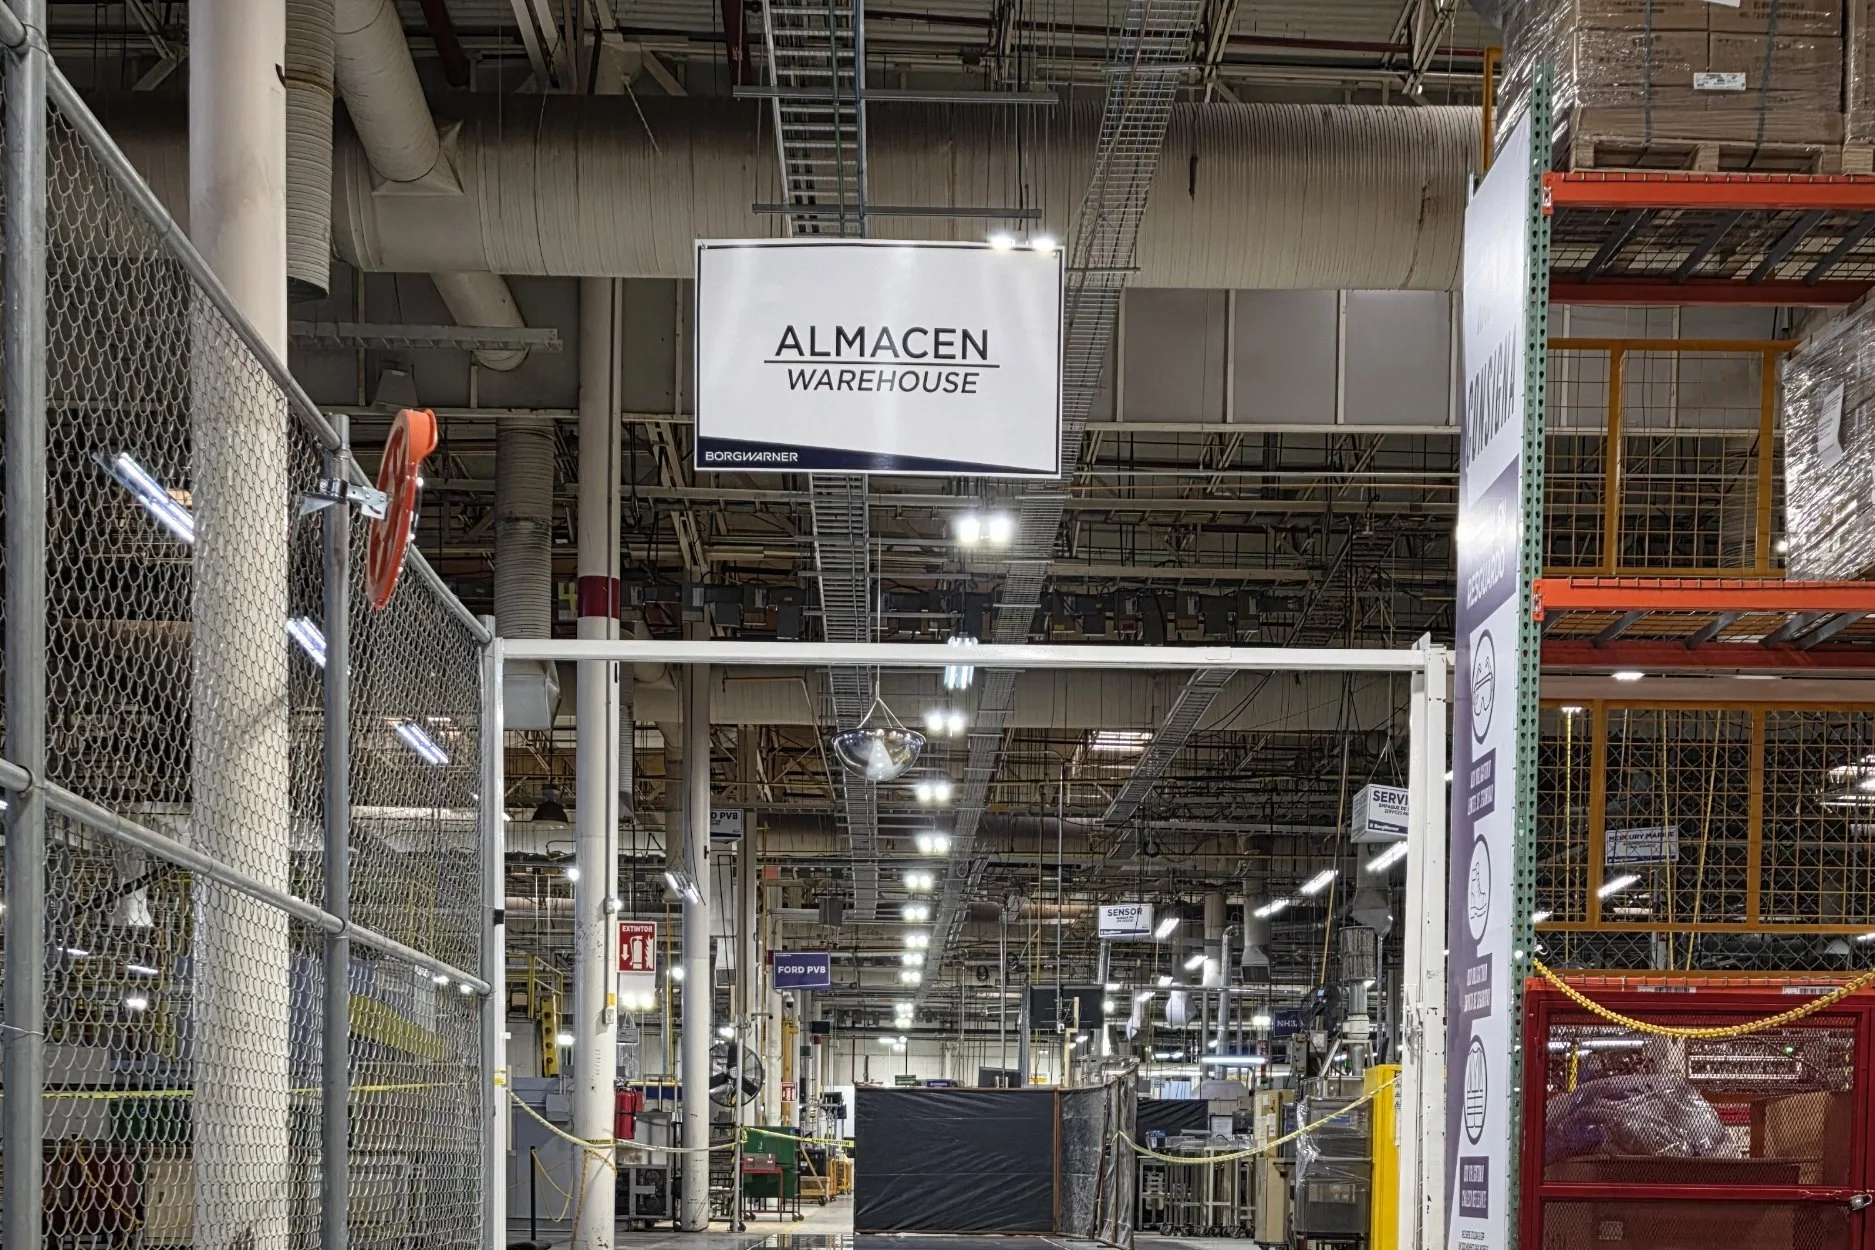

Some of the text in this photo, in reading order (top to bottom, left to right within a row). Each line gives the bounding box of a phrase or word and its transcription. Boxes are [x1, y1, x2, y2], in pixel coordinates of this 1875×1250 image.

[775, 324, 989, 361] ALMACEN
[787, 367, 980, 394] WAREHOUSE
[1466, 322, 1516, 469] CONSIGNA
[704, 450, 799, 463] BORGWARNER
[720, 811, 738, 819] PV8
[1107, 907, 1143, 917] SENSOR
[622, 925, 653, 933] EXTINTOR
[778, 965, 826, 974] FORD PV8
